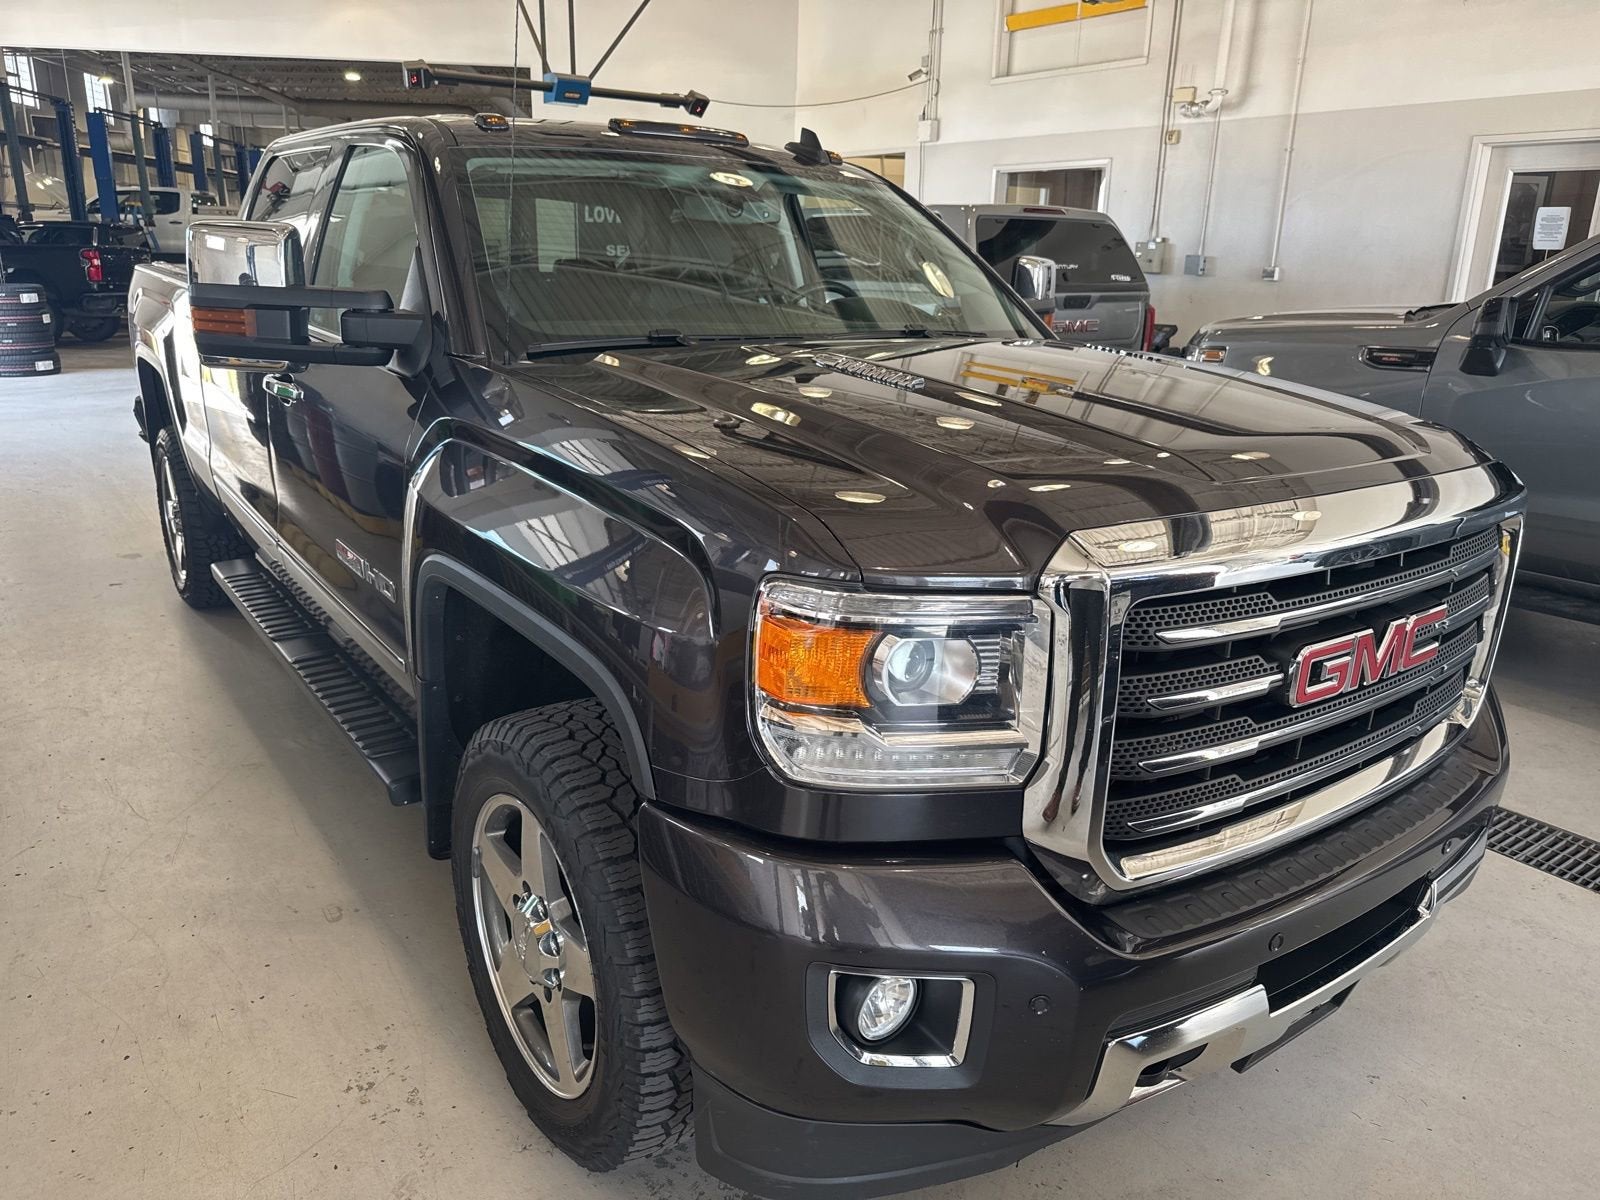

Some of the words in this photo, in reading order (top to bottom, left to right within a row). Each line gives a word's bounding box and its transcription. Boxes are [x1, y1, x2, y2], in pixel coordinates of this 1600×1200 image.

[605, 244, 631, 257] SE
[1053, 319, 1100, 334] GMC
[1288, 603, 1448, 708] GMC
